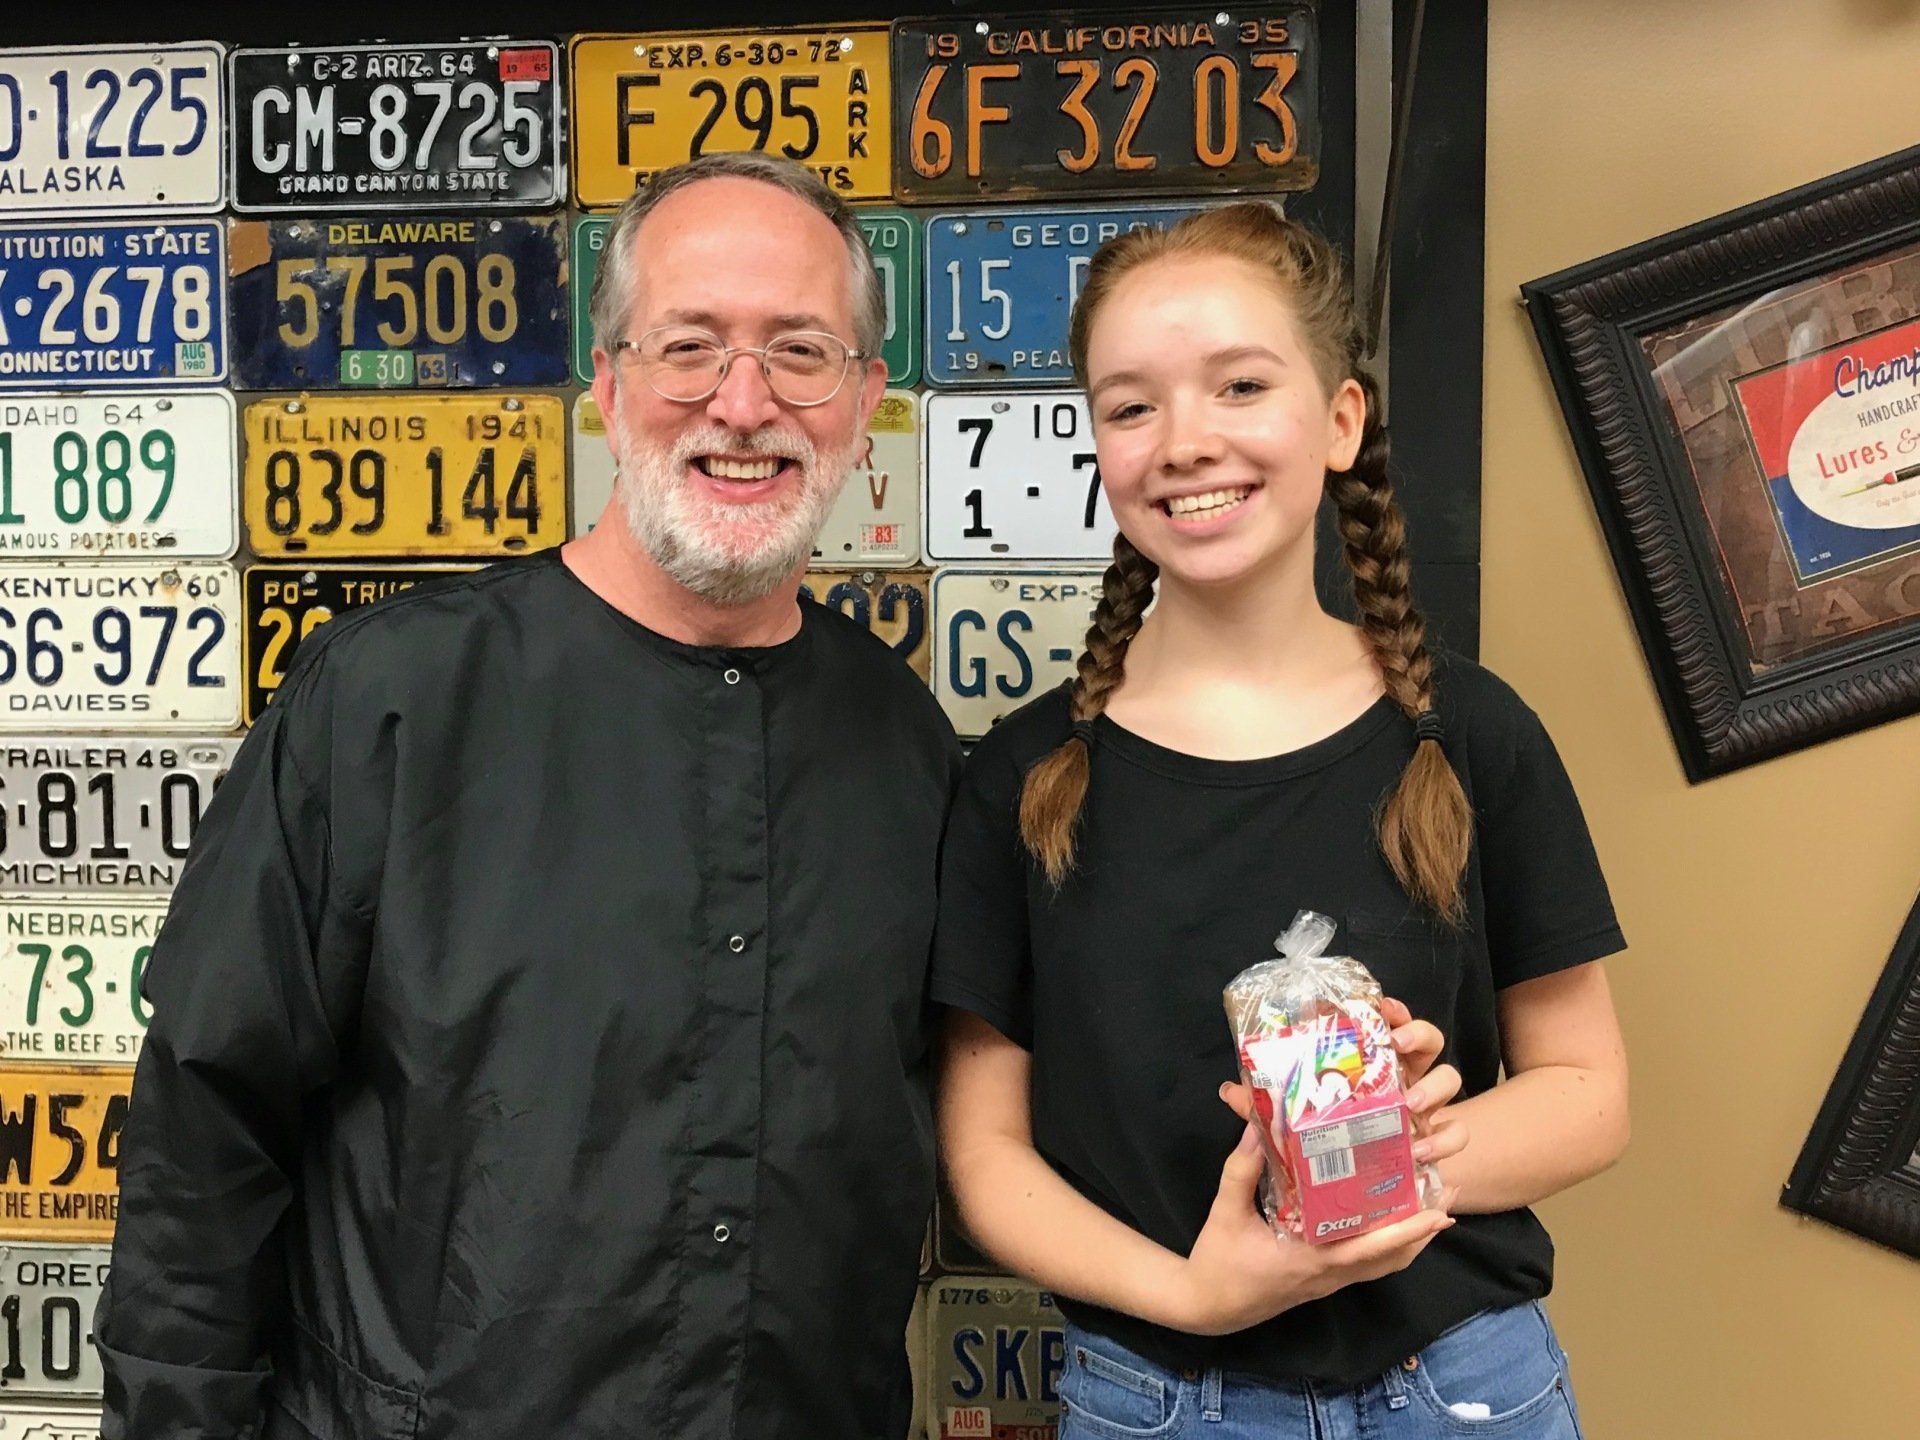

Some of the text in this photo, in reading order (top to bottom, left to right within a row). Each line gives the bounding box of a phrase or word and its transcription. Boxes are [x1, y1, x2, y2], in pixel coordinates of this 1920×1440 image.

[927, 19, 1289, 58] 19 CALIFORNIA 35
[648, 39, 841, 69] EXP. 6-30- 72
[314, 52, 475, 80] C-2 ARIZ. 64
[506, 63, 548, 74] 19 65
[616, 73, 820, 166] F 295
[909, 50, 1299, 179] 6F 32 03
[252, 79, 544, 174] CM-8725
[0, 165, 126, 195] ALASKA
[278, 171, 511, 195] GRAND CANYON STATE
[328, 222, 475, 245] DELAWARE
[863, 226, 898, 248] 70
[0, 231, 210, 260] ITUTION STATE
[276, 253, 518, 347] 57508
[946, 259, 1012, 341] 15
[0, 349, 155, 375] ONNECTICUT
[181, 343, 206, 360] AUG
[949, 350, 1074, 371] 19 PEA
[182, 360, 206, 371] 1980
[420, 360, 445, 379] 63
[0, 404, 144, 427] DAHO 64
[1857, 394, 1920, 428] HANDCRAF
[263, 414, 544, 443] ILLINOIS 1941
[1816, 440, 1889, 479] Lures
[53, 429, 176, 524] 889
[264, 446, 542, 536] 839 144
[70, 532, 160, 549] POTATOES
[876, 526, 891, 543] 83
[187, 575, 220, 598] 60
[9, 694, 151, 711] DAVIESS
[0, 748, 178, 769] RAILER 48
[0, 863, 174, 886] MICHIGAN
[7, 1031, 43, 1052] THE
[54, 1032, 104, 1053] BEEF
[1301, 1124, 1340, 1137] Nutrition
[1302, 1133, 1327, 1143] Facts
[0, 1192, 119, 1220] HE EMPIRE
[1315, 1214, 1363, 1237] Extra
[938, 1288, 989, 1305] 1776
[953, 1410, 985, 1430] AUG
